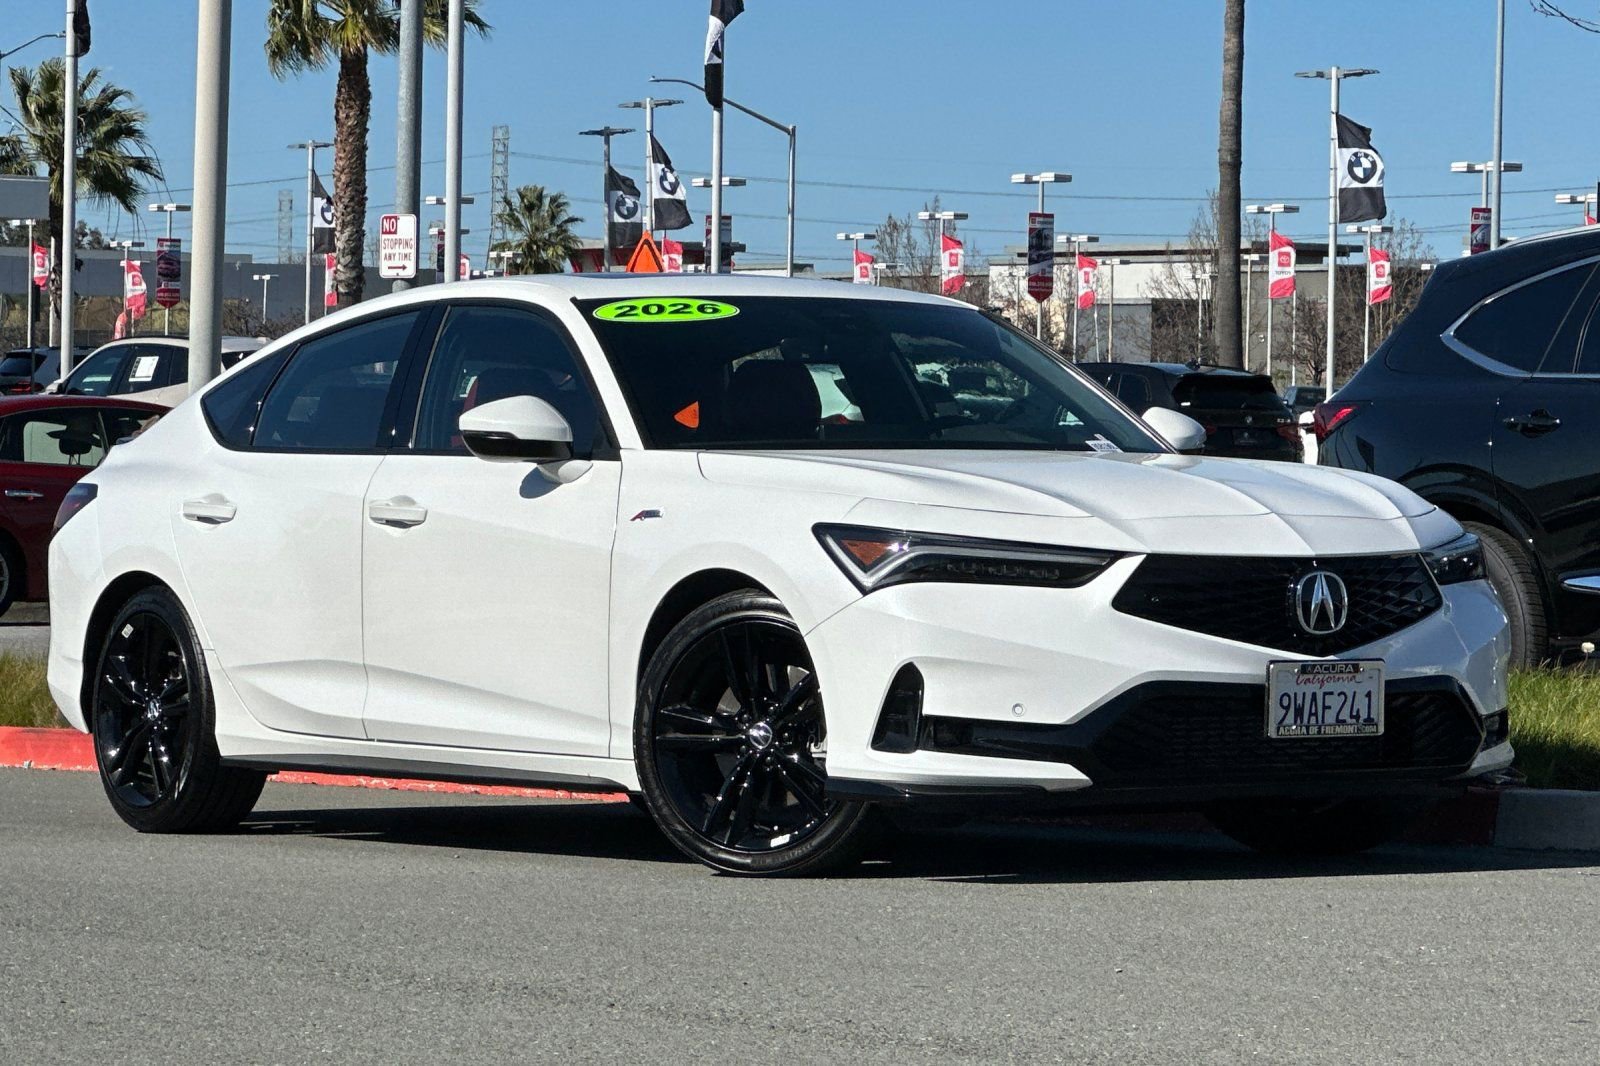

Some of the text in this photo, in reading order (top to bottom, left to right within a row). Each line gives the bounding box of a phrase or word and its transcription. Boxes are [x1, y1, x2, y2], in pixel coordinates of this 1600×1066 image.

[383, 217, 396, 232] NO
[383, 238, 413, 250] STOPPING
[384, 252, 412, 261] ANY TIME
[613, 303, 702, 319] 2026
[1313, 663, 1354, 674] ACURA
[1296, 672, 1357, 690] California
[1277, 689, 1376, 726] 9WAF241
[1279, 725, 1307, 736] ACURA
[1309, 725, 1319, 735] OF
